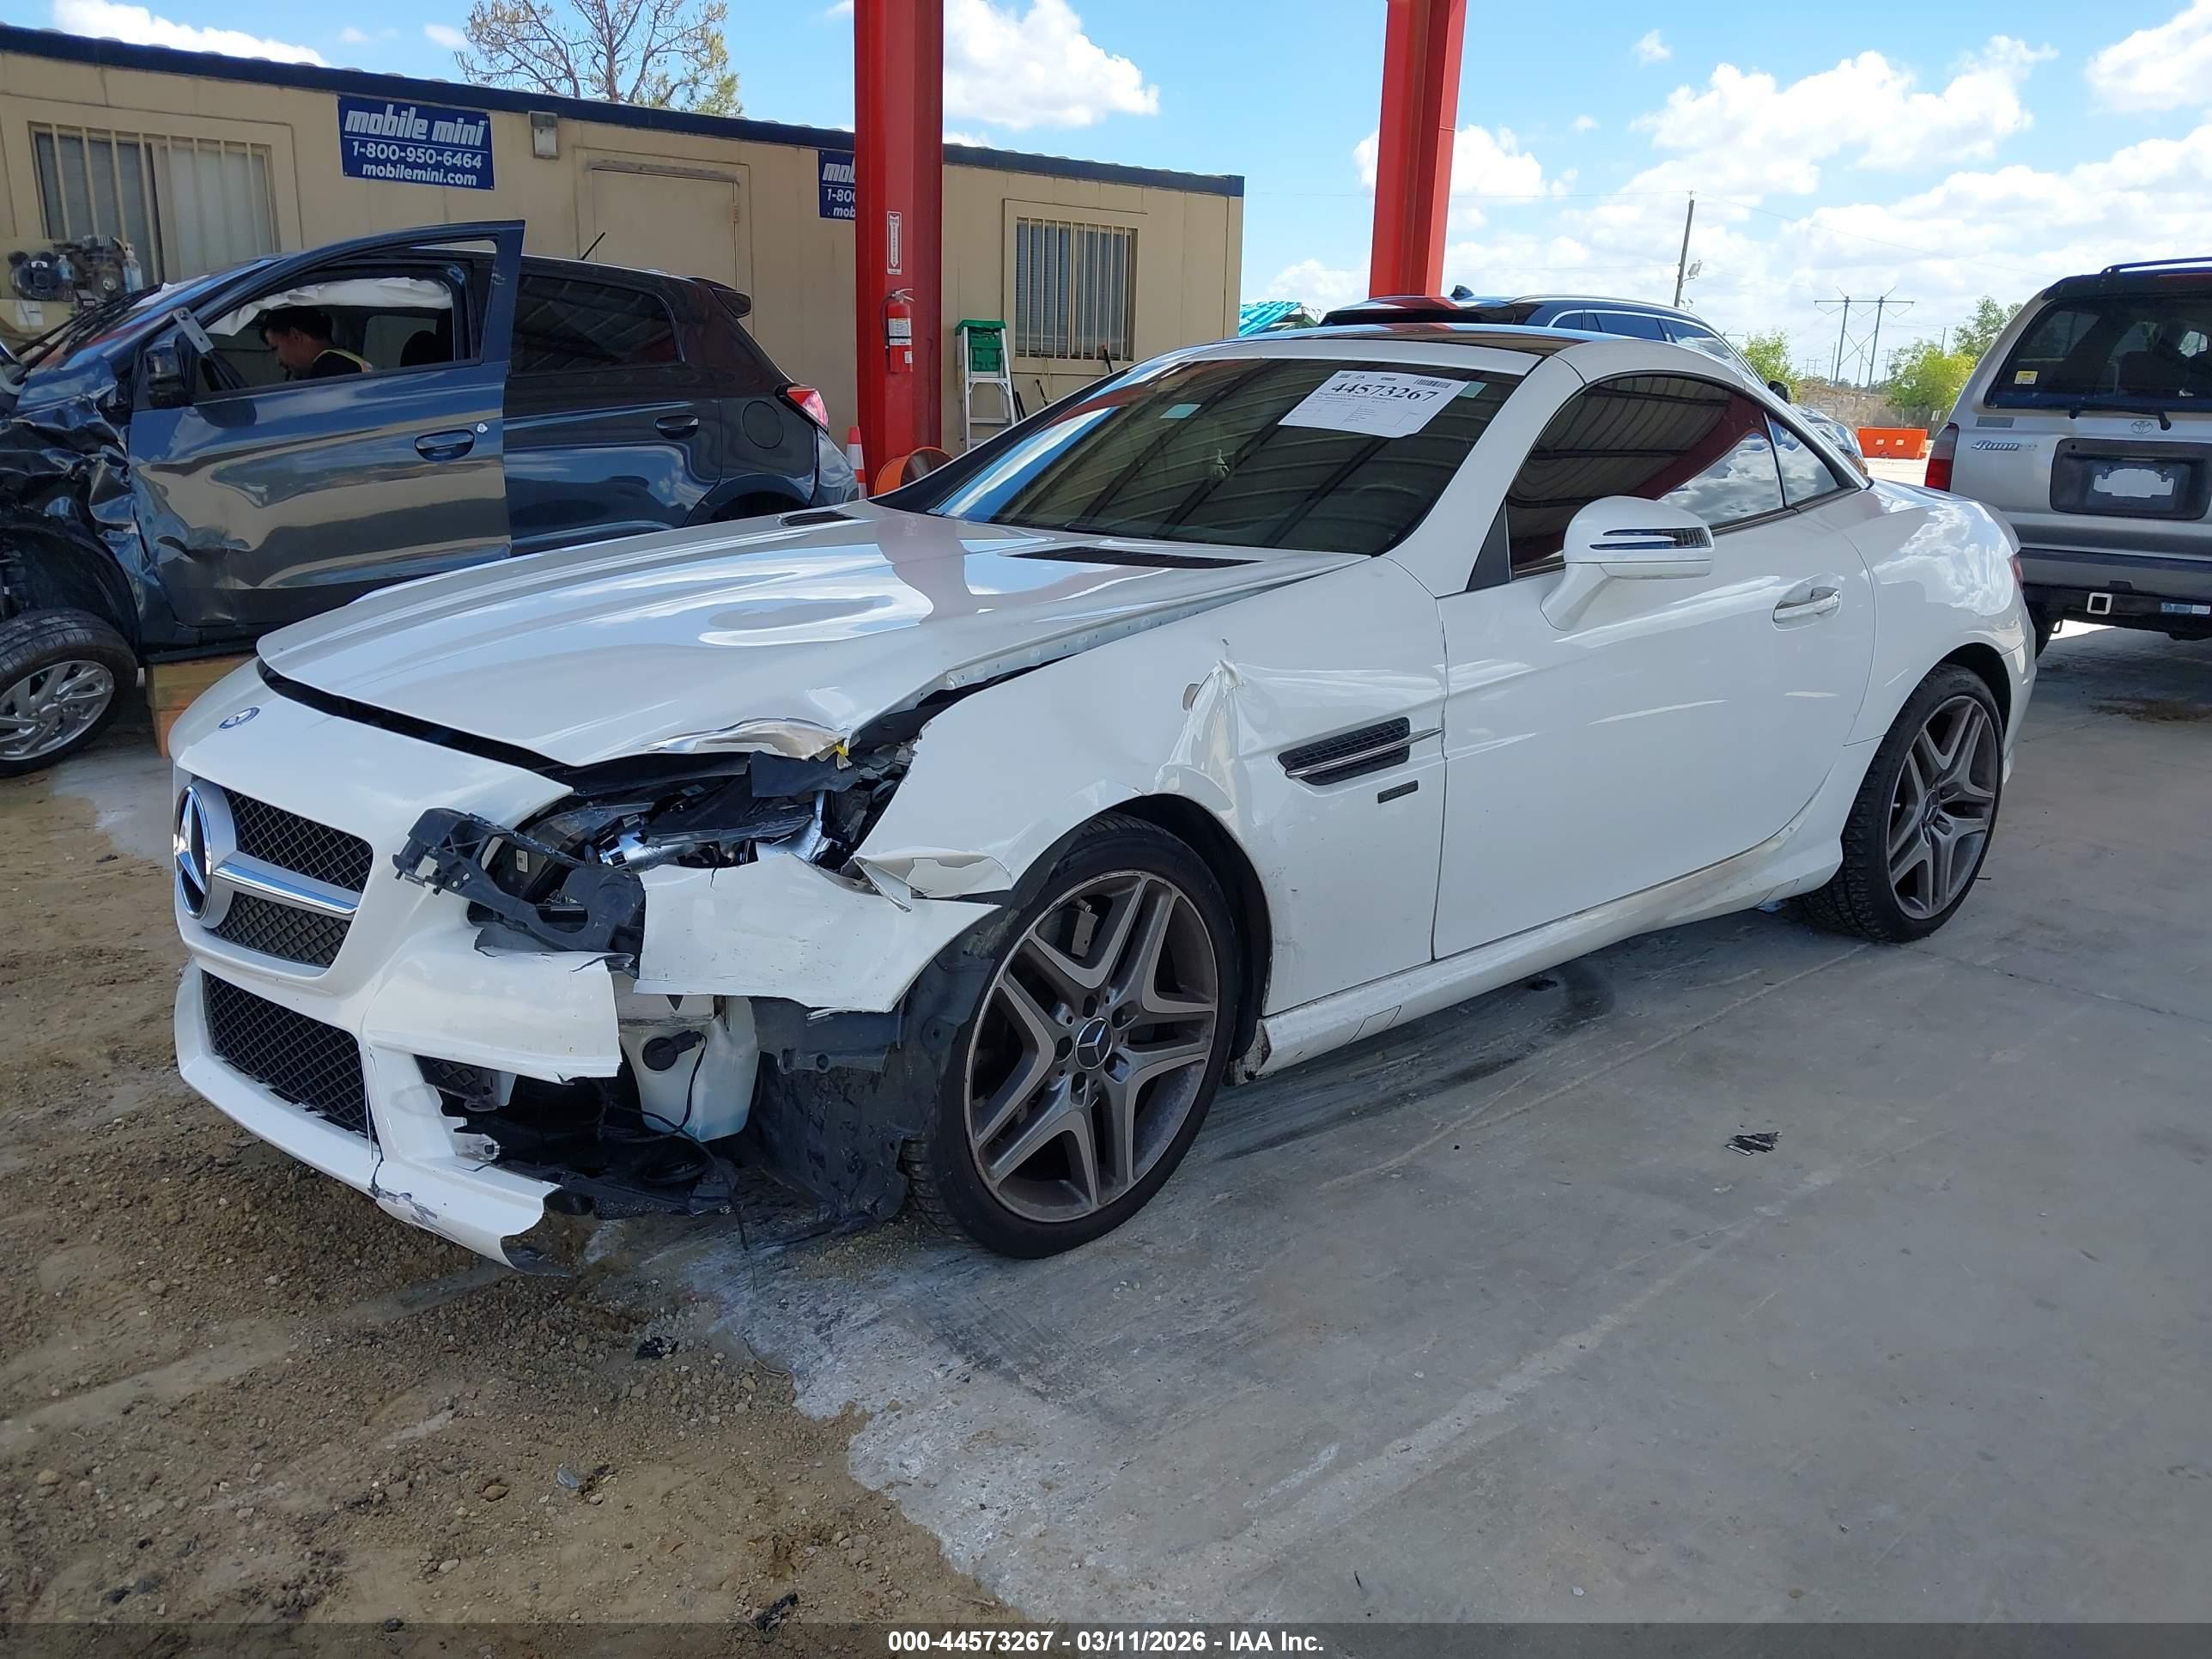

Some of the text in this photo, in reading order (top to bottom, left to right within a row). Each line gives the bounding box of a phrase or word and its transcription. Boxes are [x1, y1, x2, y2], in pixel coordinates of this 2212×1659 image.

[344, 103, 486, 146] mobile mini
[352, 141, 483, 169] 1-800-950-6464
[362, 163, 477, 186] mobilemini.com
[1331, 382, 1440, 403] 44573267
